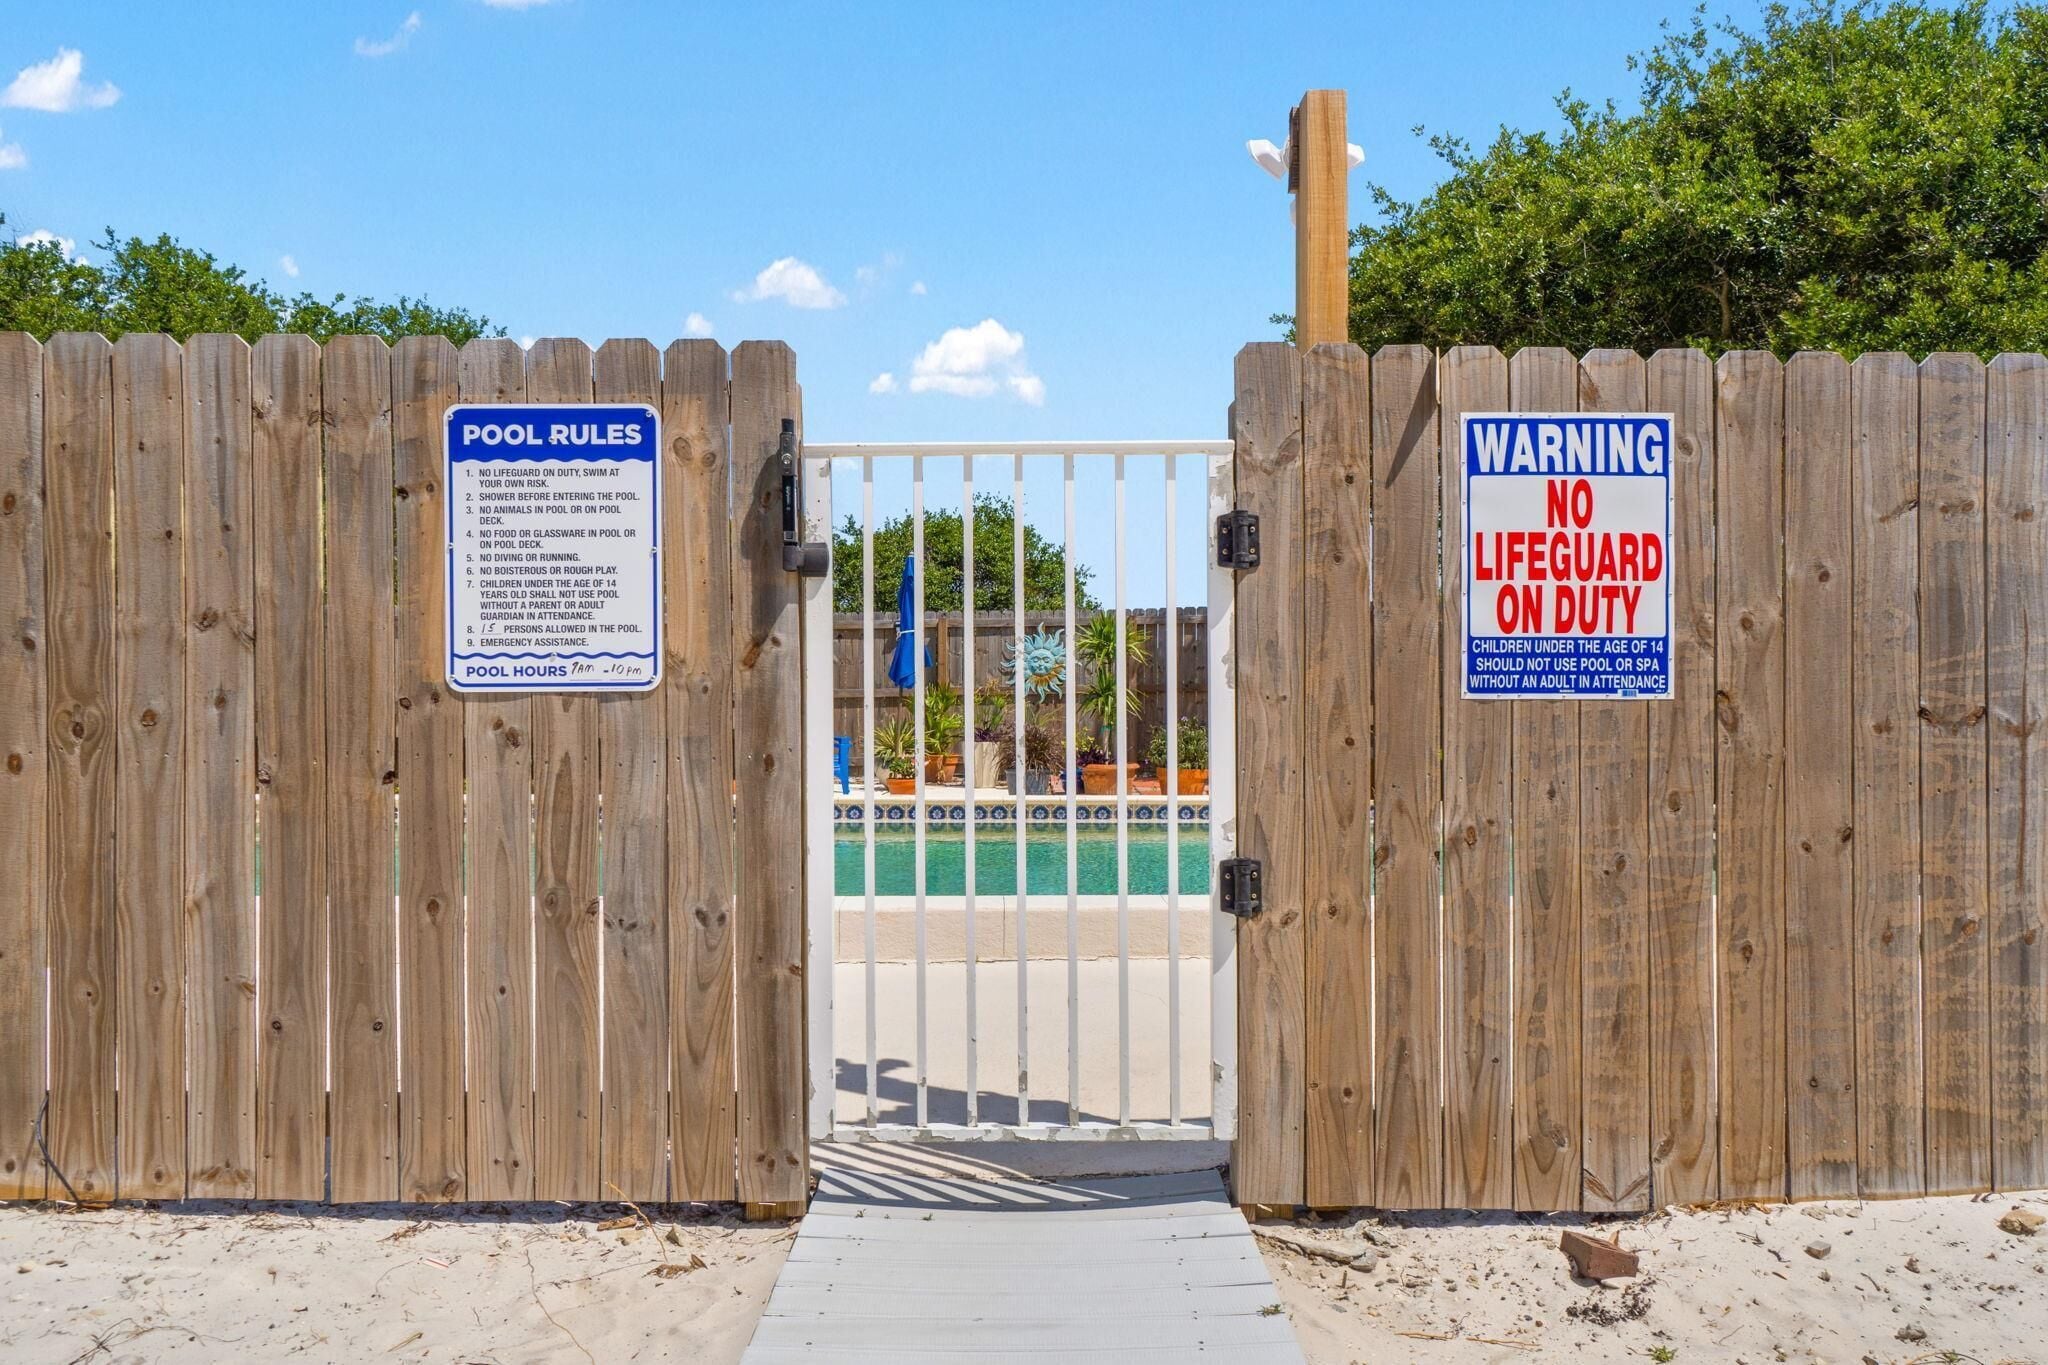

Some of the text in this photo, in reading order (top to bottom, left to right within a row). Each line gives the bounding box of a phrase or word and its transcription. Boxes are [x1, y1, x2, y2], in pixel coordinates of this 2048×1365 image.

[464, 424, 642, 445] POOL RULES
[1473, 423, 1663, 473] WARNING
[466, 469, 620, 477] 1. NO LIFEGUARD ON DUTY, SWIM AT
[480, 480, 549, 488] YOUR OWN RISK.
[466, 493, 640, 501] 2. SHOWER BEFORE ENTERING THE POOL.
[1547, 479, 1593, 528] NO
[466, 506, 621, 514] 3. NO ANIMALS IN POOL OR ON POOL
[480, 517, 504, 525] DECK.
[466, 530, 636, 538] 4. NO FOOD OR GLASSWARE IN POOL OR
[480, 541, 543, 549] ON POOL DECK.
[467, 554, 581, 562] 5. NO DIVING OR RUNNING.
[1476, 532, 1662, 581] LIFEGUARD
[467, 567, 617, 575] 6. NO BOISTEROUS OR ROUGH PLAY.
[467, 580, 616, 588] 7. CHILDREN UNDER THE AGE OF 14
[481, 591, 619, 599] YEARS OLD SHALL NOT USE POOL
[481, 601, 605, 609] WITHOUT A PARENT OR ADULT
[1497, 584, 1642, 634] ON DUTY
[481, 612, 595, 620] GUARDIAN IN ATTENDANCE.
[467, 625, 474, 633] 8.
[504, 625, 543, 633] PERSONS
[545, 625, 586, 633] ALLOWED
[589, 625, 597, 633] IN
[600, 625, 615, 633] THE
[618, 625, 642, 633] POOL.
[467, 638, 589, 647] 9. EMERGENCY ASSISTANCE.
[1473, 640, 1663, 653] CHILDREN UNDER THE AGE OF 14
[1476, 657, 1659, 671] SHOULD NOT USE POOL OR SPA
[467, 666, 567, 677] POOL HOURS
[1470, 674, 1665, 688] WITHOUT AN ADULT IN ATTENDANCE
